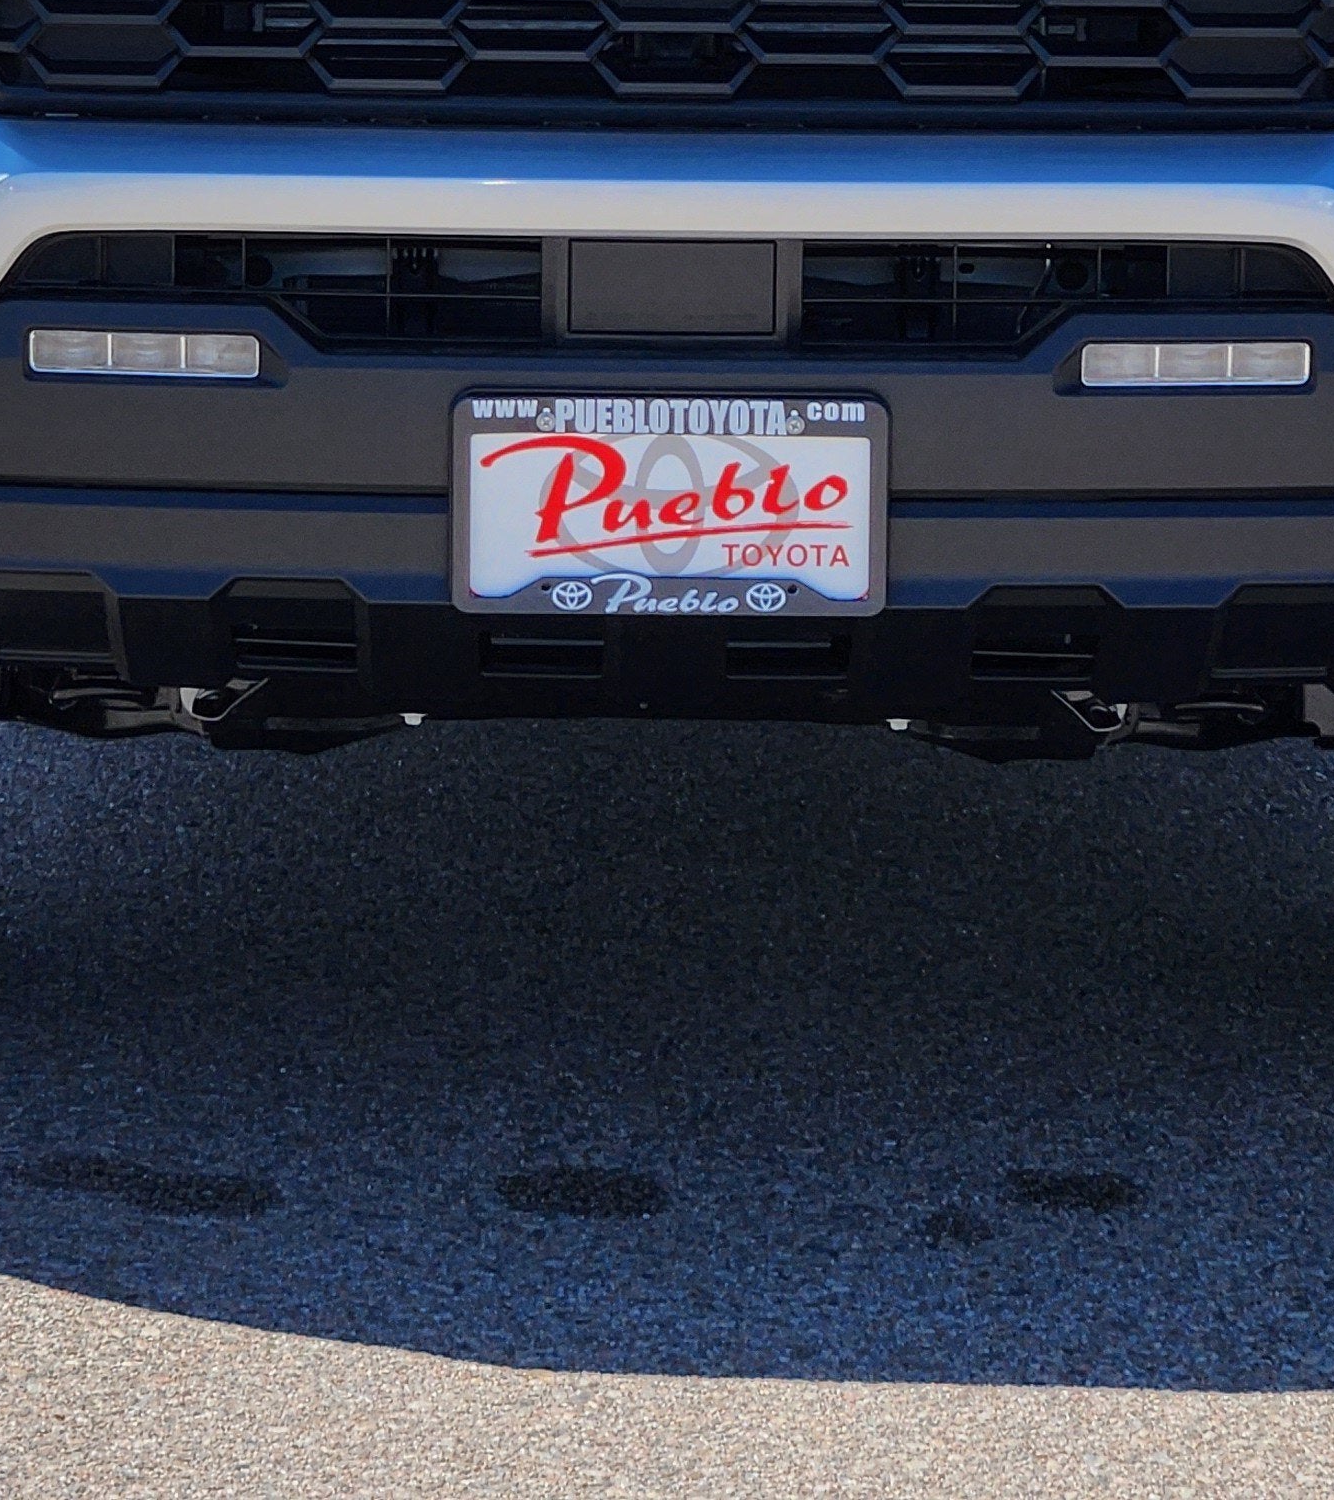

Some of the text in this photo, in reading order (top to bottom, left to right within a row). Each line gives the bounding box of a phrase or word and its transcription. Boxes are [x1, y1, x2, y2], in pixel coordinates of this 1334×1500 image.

[480, 435, 848, 543] Pueblo
[722, 544, 850, 567] TOYOTA
[590, 573, 739, 613] Pueblo
